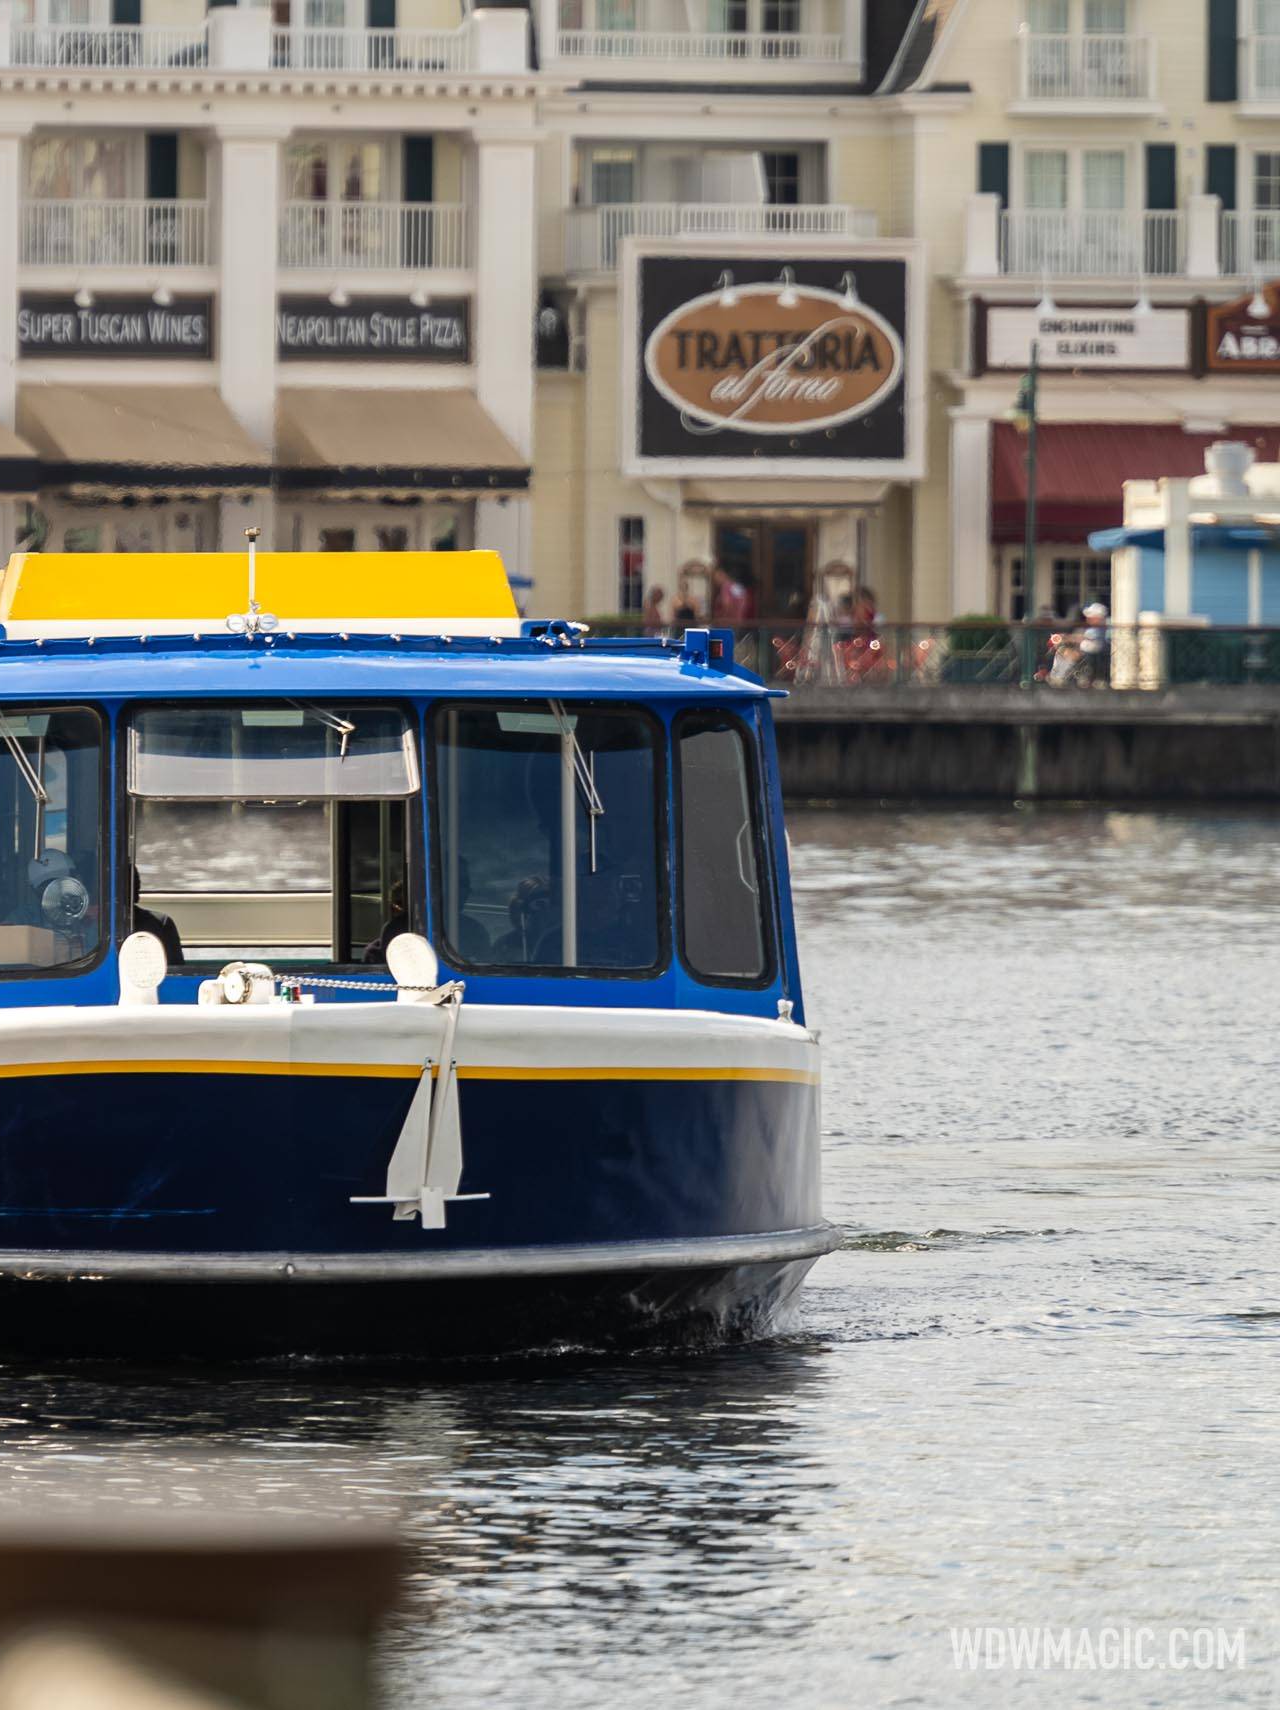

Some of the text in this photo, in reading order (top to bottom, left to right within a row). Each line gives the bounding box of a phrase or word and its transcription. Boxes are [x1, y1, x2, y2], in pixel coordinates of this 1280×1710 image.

[18, 310, 205, 344] SUPER TUSCAN WINES
[275, 312, 464, 347] NEAPOLITAN STYLE PIZZA
[671, 329, 882, 372] TRATTORIA
